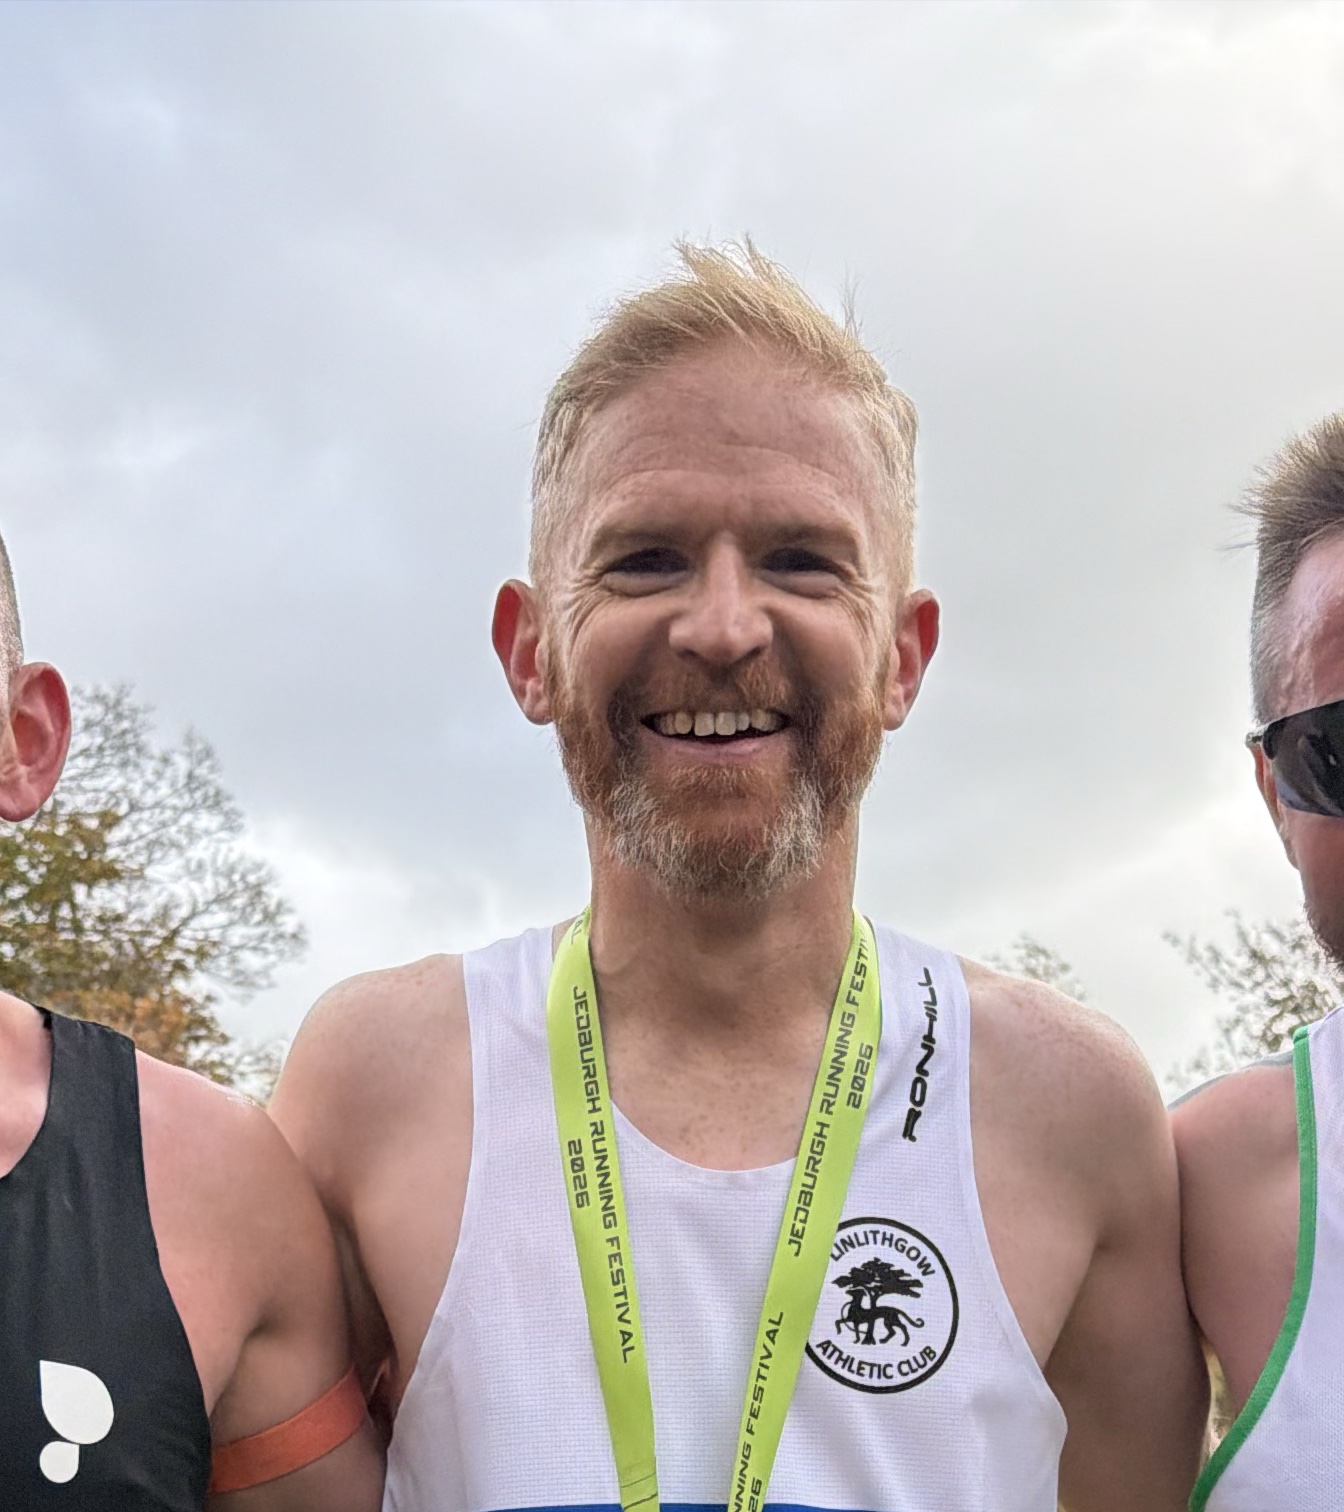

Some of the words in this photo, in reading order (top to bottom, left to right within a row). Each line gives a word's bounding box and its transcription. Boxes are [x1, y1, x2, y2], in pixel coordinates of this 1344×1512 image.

[846, 1042, 873, 1109] 2026
[902, 967, 937, 1142] RONHILL
[567, 1138, 590, 1209] 2026
[573, 986, 602, 1114] JEDBURGH
[589, 1120, 618, 1229] RUNNING
[606, 1236, 635, 1364] FESTIVAL
[788, 1121, 830, 1257] JEDBURGH
[819, 1011, 856, 1115] RUNNING
[746, 1311, 784, 1436] FESTIVAL
[815, 1339, 893, 1379] ATHLETIC
[897, 1345, 937, 1377] CLUB
